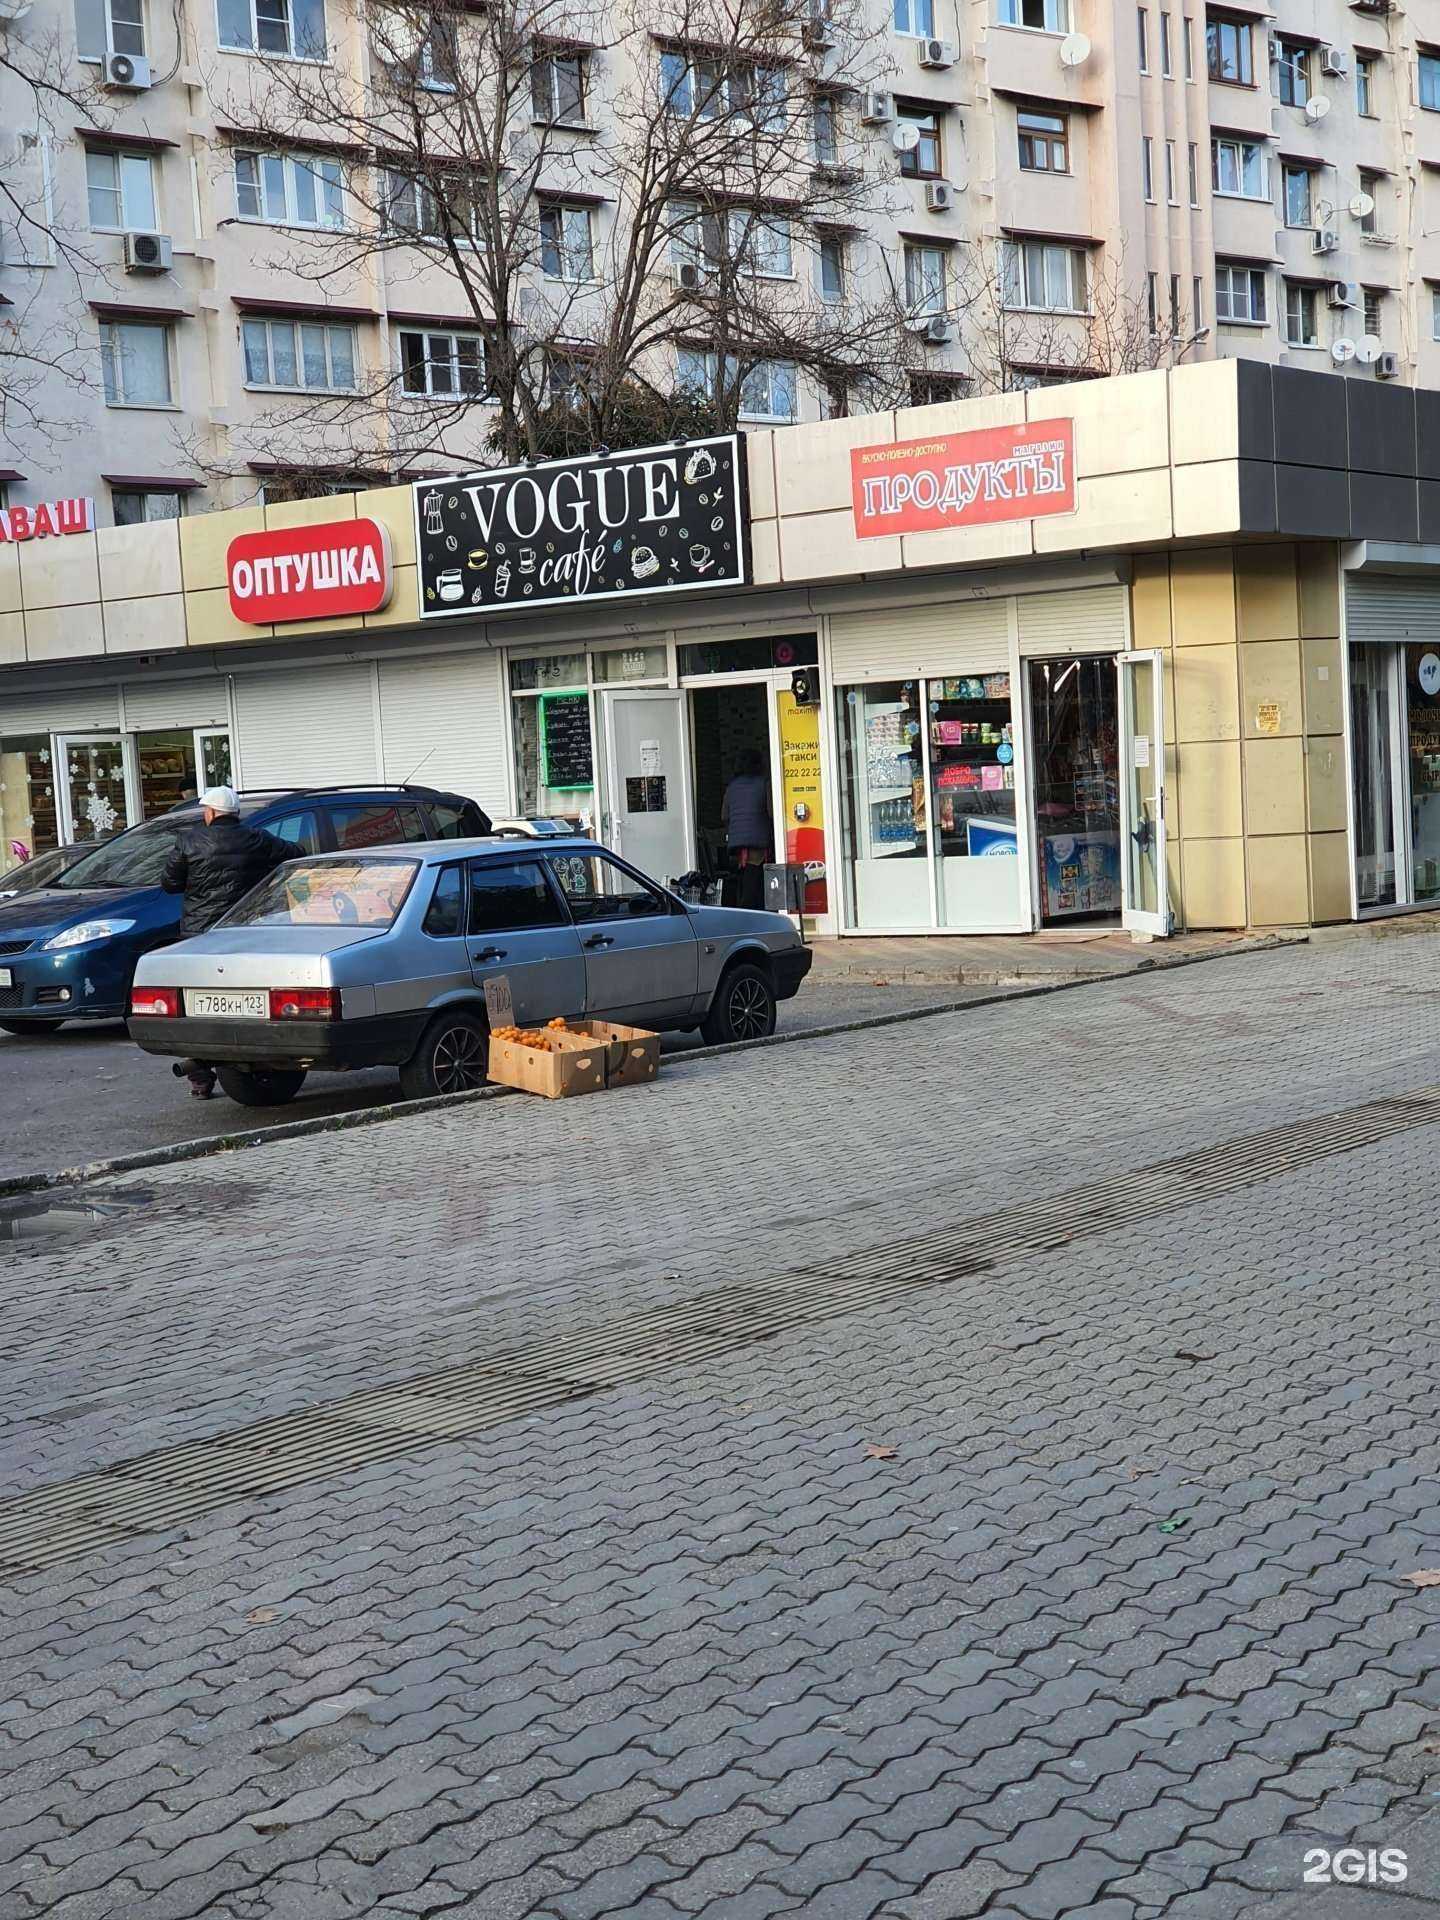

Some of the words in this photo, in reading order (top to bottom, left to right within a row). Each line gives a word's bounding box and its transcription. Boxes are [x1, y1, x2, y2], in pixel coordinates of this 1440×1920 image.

[462, 458, 681, 544] VOGUE
[863, 452, 1065, 517] ПРОДУКТЫ
[232, 545, 381, 598] ОПТУШКА
[539, 529, 607, 596] café
[790, 752, 817, 762] такси
